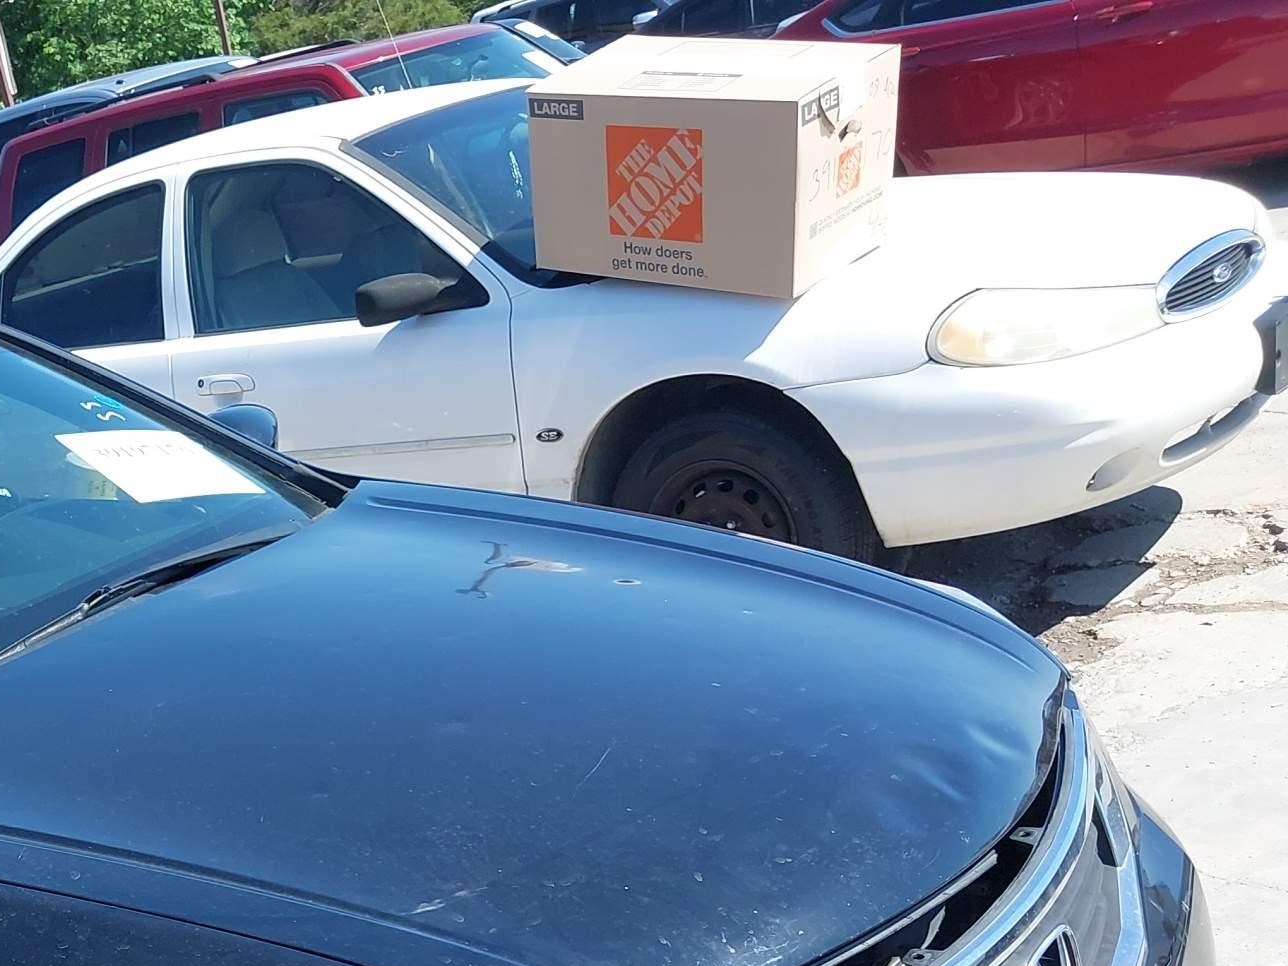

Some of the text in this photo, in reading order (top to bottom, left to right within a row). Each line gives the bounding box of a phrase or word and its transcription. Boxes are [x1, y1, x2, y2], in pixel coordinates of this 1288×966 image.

[533, 102, 578, 116] LARGE
[804, 91, 839, 121] LAGE
[615, 138, 655, 182] THE
[609, 129, 702, 236] HOME
[645, 171, 703, 239] DEPOT
[612, 258, 633, 270] get
[635, 260, 668, 273] more
[623, 241, 693, 260] How doers
